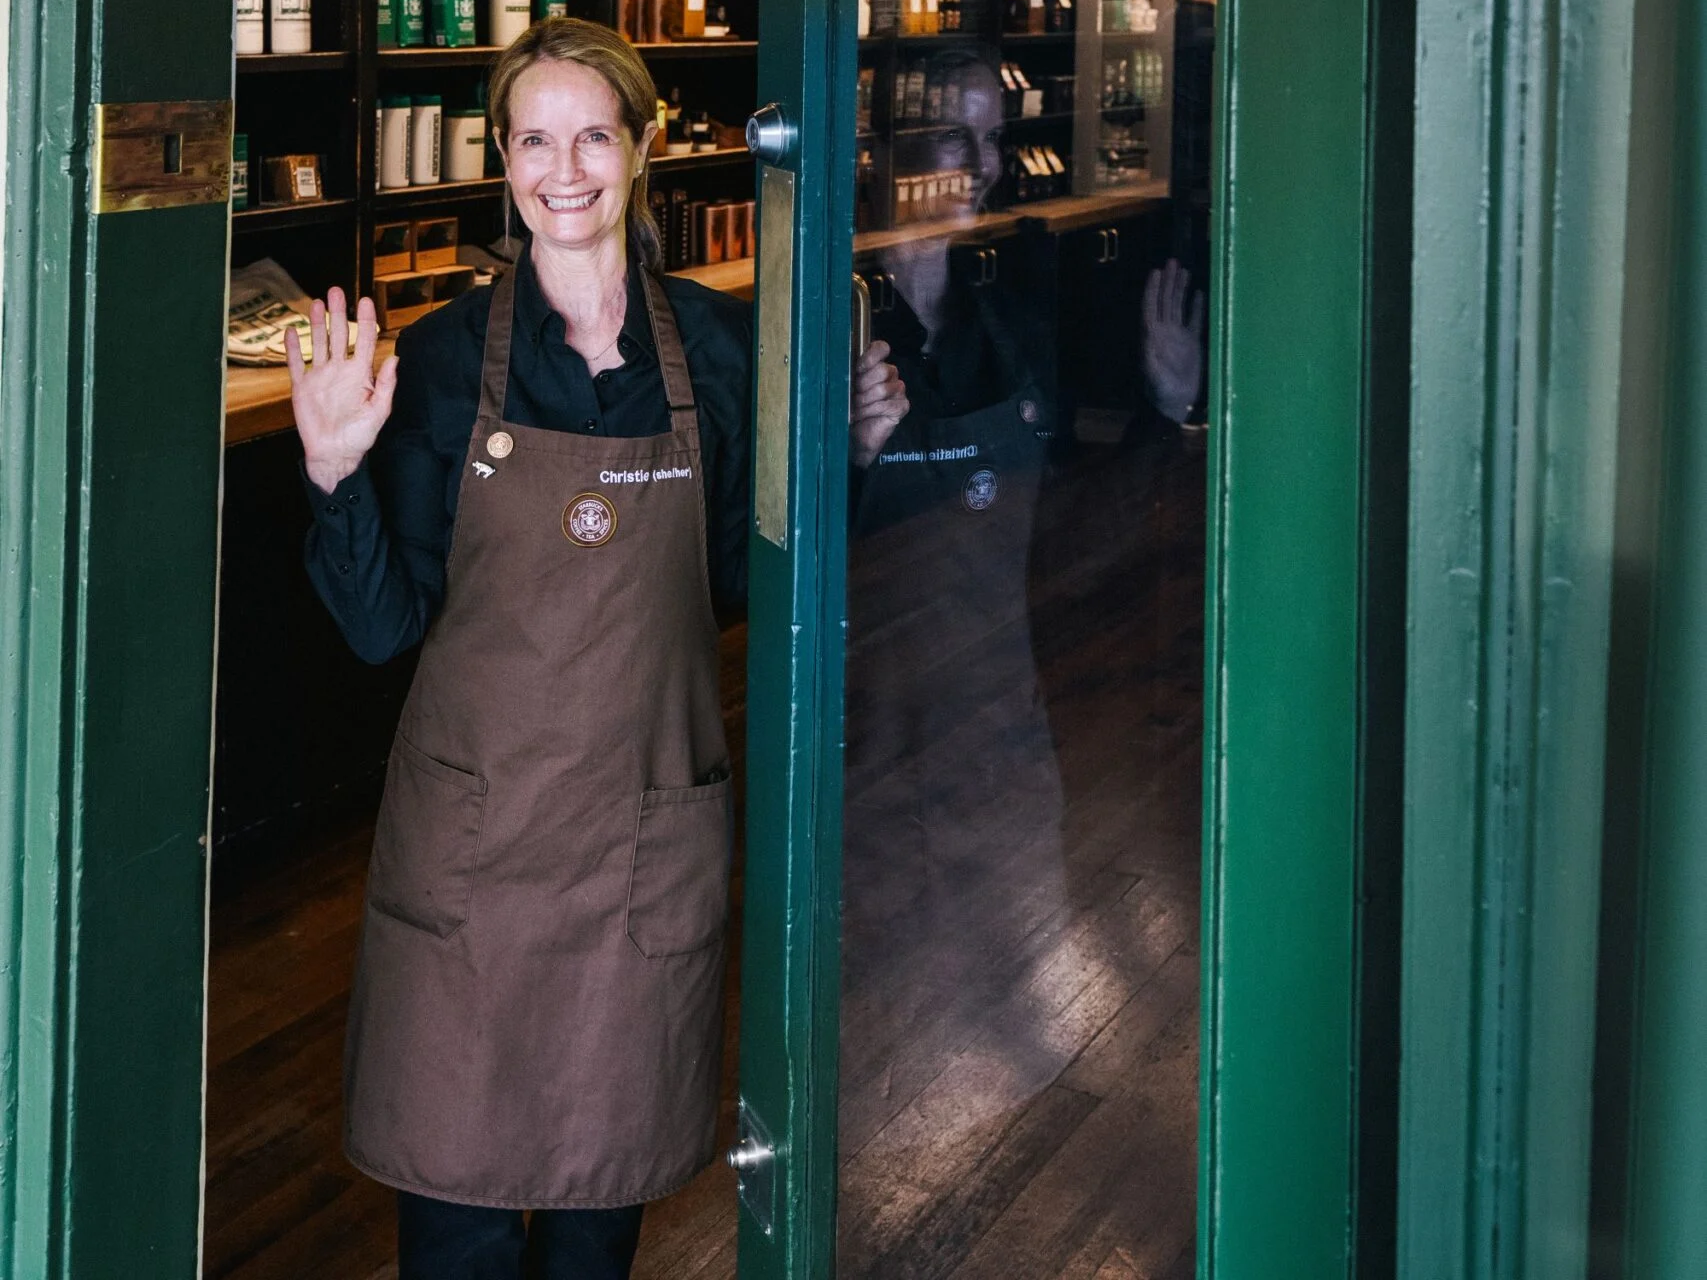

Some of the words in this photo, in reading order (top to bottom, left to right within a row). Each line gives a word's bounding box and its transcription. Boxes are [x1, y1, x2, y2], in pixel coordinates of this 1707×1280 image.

[600, 469, 650, 484] Christie
[652, 466, 692, 482] (she/her)
[578, 502, 603, 512] STARBUCKS
